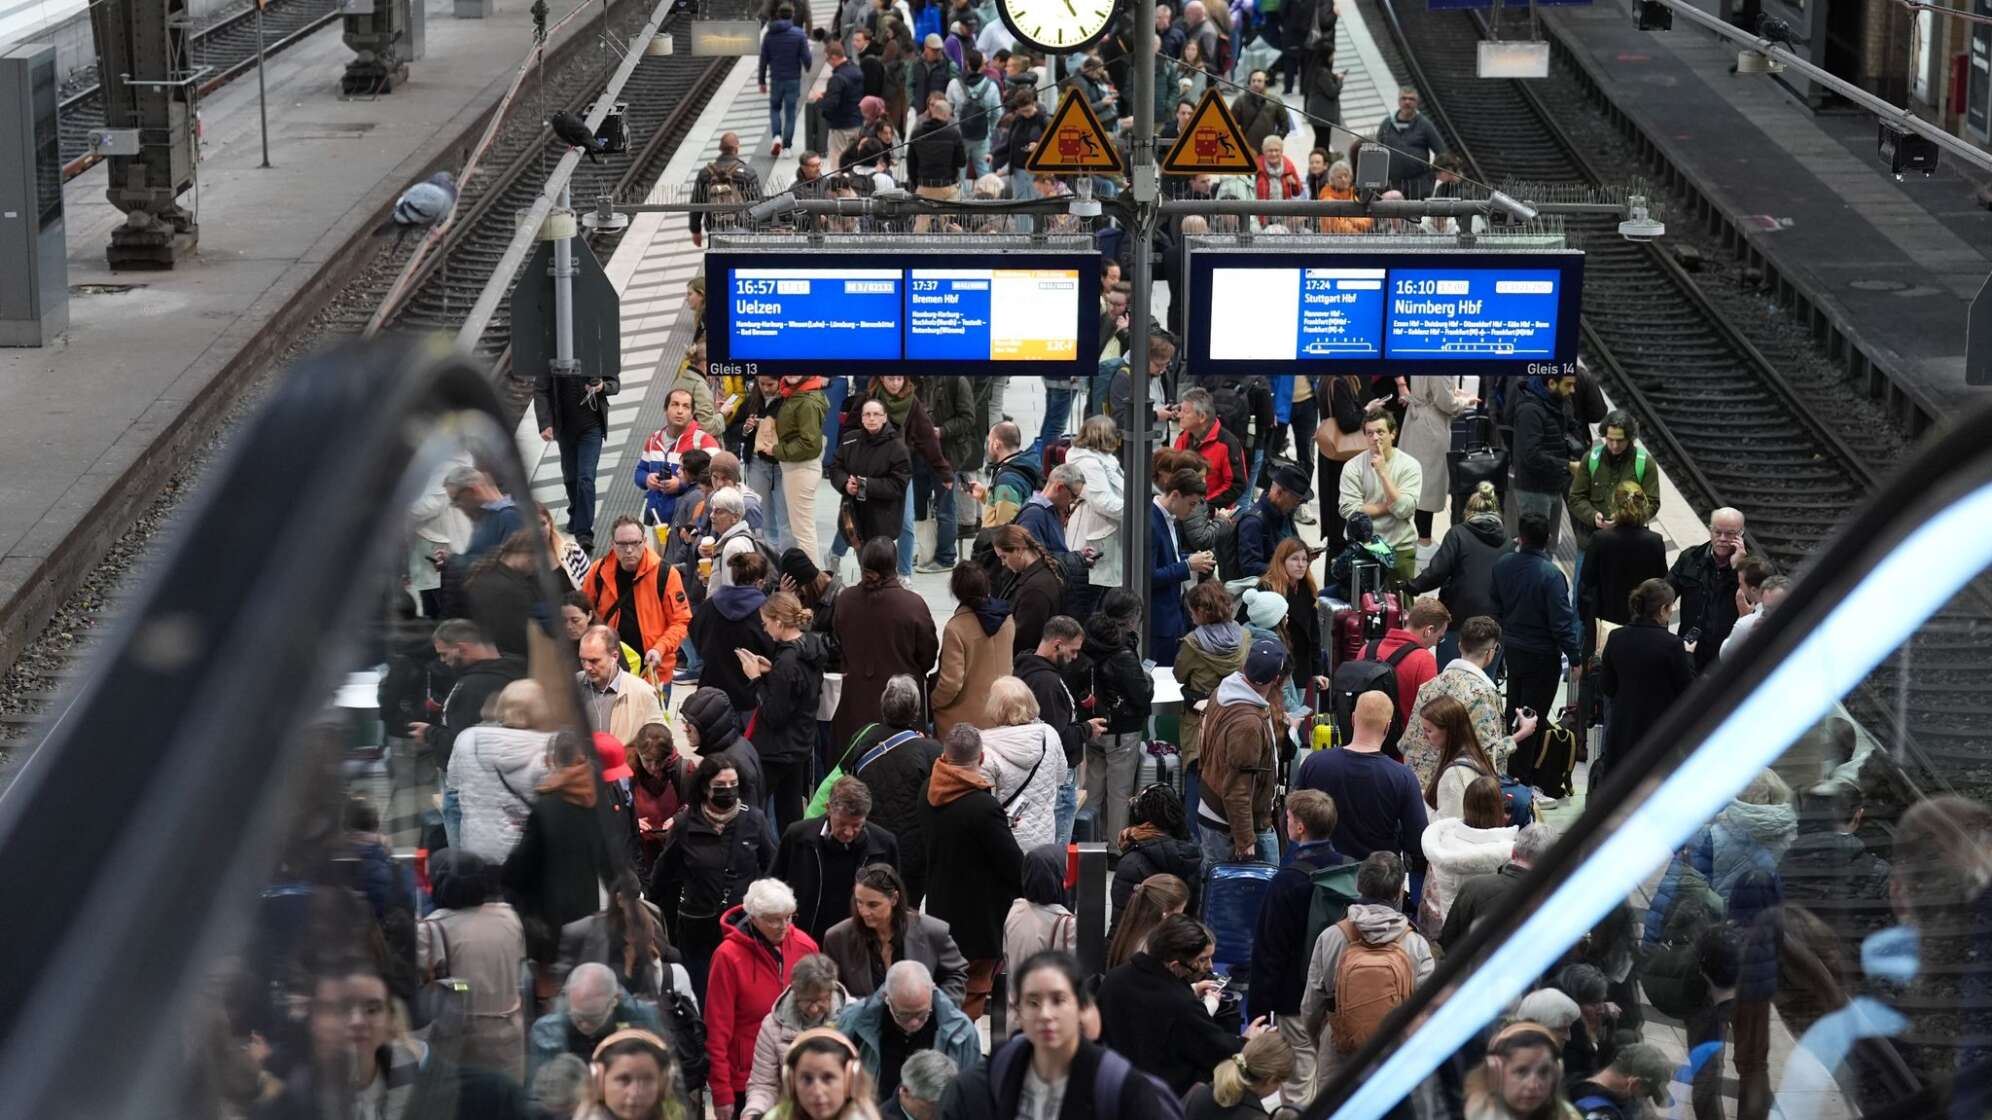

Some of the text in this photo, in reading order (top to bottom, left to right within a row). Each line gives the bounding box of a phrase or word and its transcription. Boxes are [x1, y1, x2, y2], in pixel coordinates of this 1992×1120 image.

[736, 280, 776, 295] 16:57
[912, 280, 938, 291] 17:37
[1305, 280, 1331, 290] 17:24
[1396, 280, 1436, 295] 16:10
[912, 294, 959, 304] Bremen Hbf
[1304, 293, 1357, 305] Stuttgart Hbf
[736, 299, 782, 314] Uelzen
[1395, 299, 1482, 317] Nürnberg Hbf
[710, 363, 757, 374] Gleis 13
[1528, 363, 1575, 374] Gleis 14
